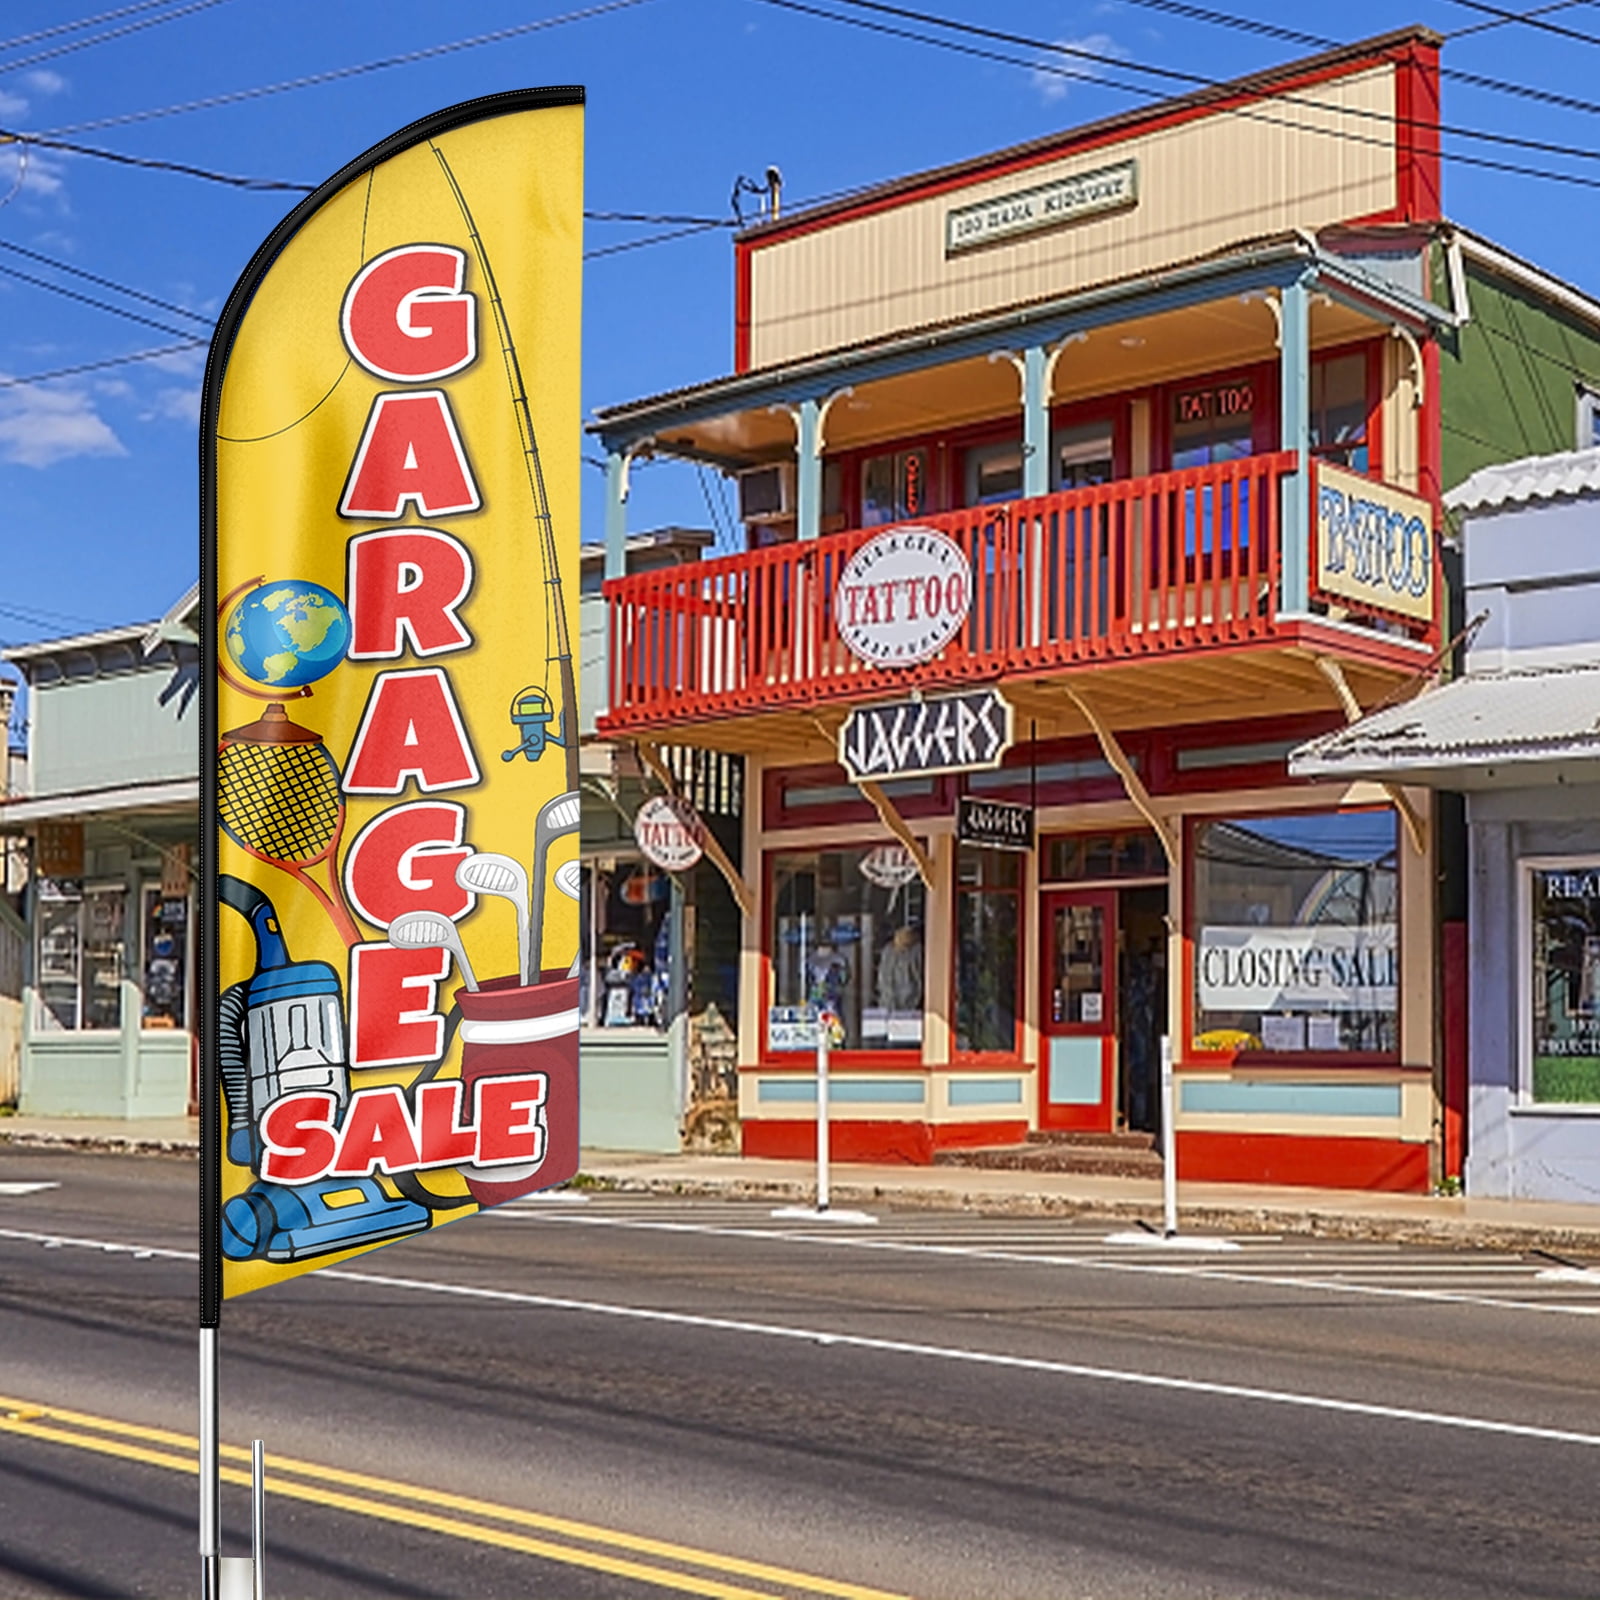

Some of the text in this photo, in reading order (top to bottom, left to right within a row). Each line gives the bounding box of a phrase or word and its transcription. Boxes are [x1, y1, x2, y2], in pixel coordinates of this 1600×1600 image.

[845, 572, 965, 627] TATTOO
[339, 242, 481, 1070] GARAGE
[848, 695, 1000, 775] JAGGERS
[1203, 945, 1325, 988] CLOSING
[259, 1072, 549, 1185] SALE
